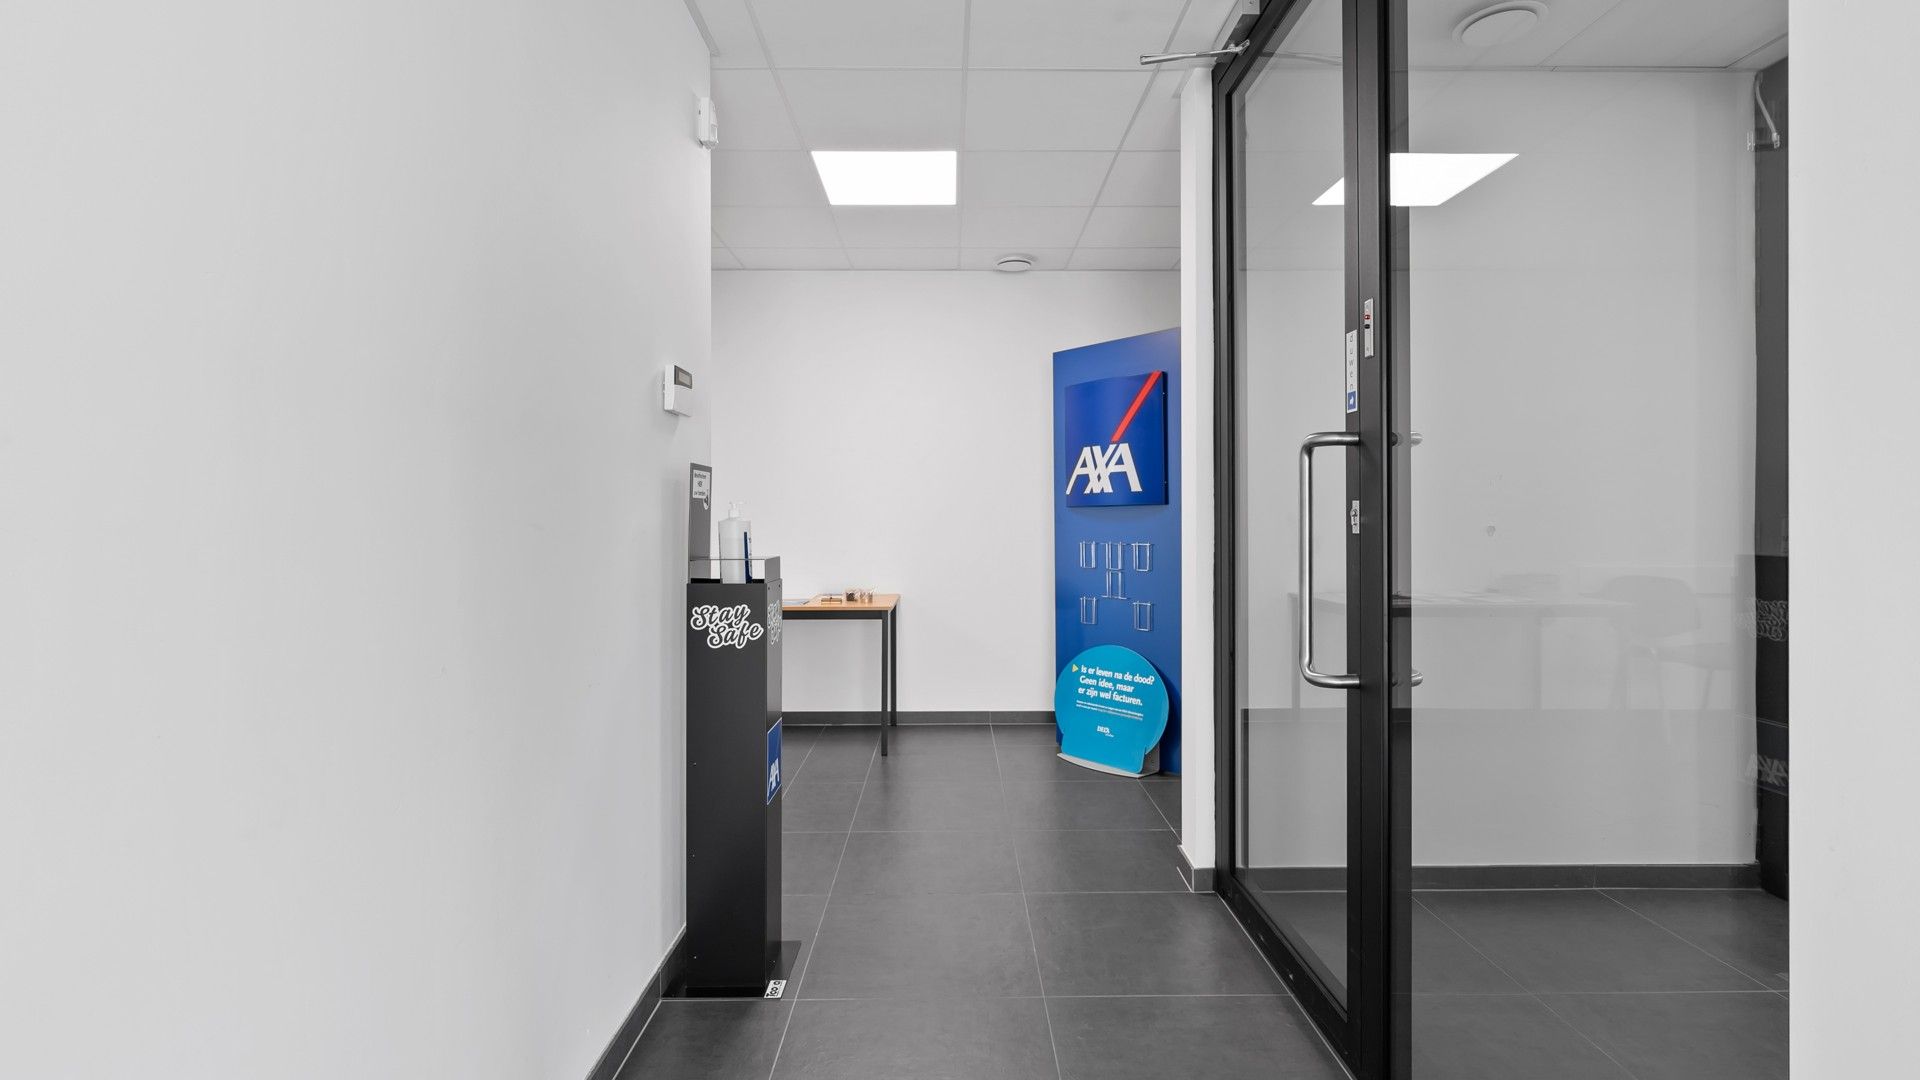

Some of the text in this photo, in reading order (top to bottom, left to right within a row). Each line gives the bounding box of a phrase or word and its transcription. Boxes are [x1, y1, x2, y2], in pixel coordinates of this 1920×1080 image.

[1065, 443, 1143, 495] AXA
[690, 604, 751, 630] Stay
[707, 621, 764, 649] Safe
[1080, 675, 1135, 693] Geen idee, maar
[1081, 665, 1087, 674] Is
[1088, 667, 1095, 675] er
[1096, 667, 1113, 677] leven
[1124, 672, 1132, 681] de
[1134, 674, 1155, 685] dood?
[1086, 687, 1098, 698] zijn
[1099, 691, 1111, 699] wel
[1112, 691, 1143, 706] facturen.
